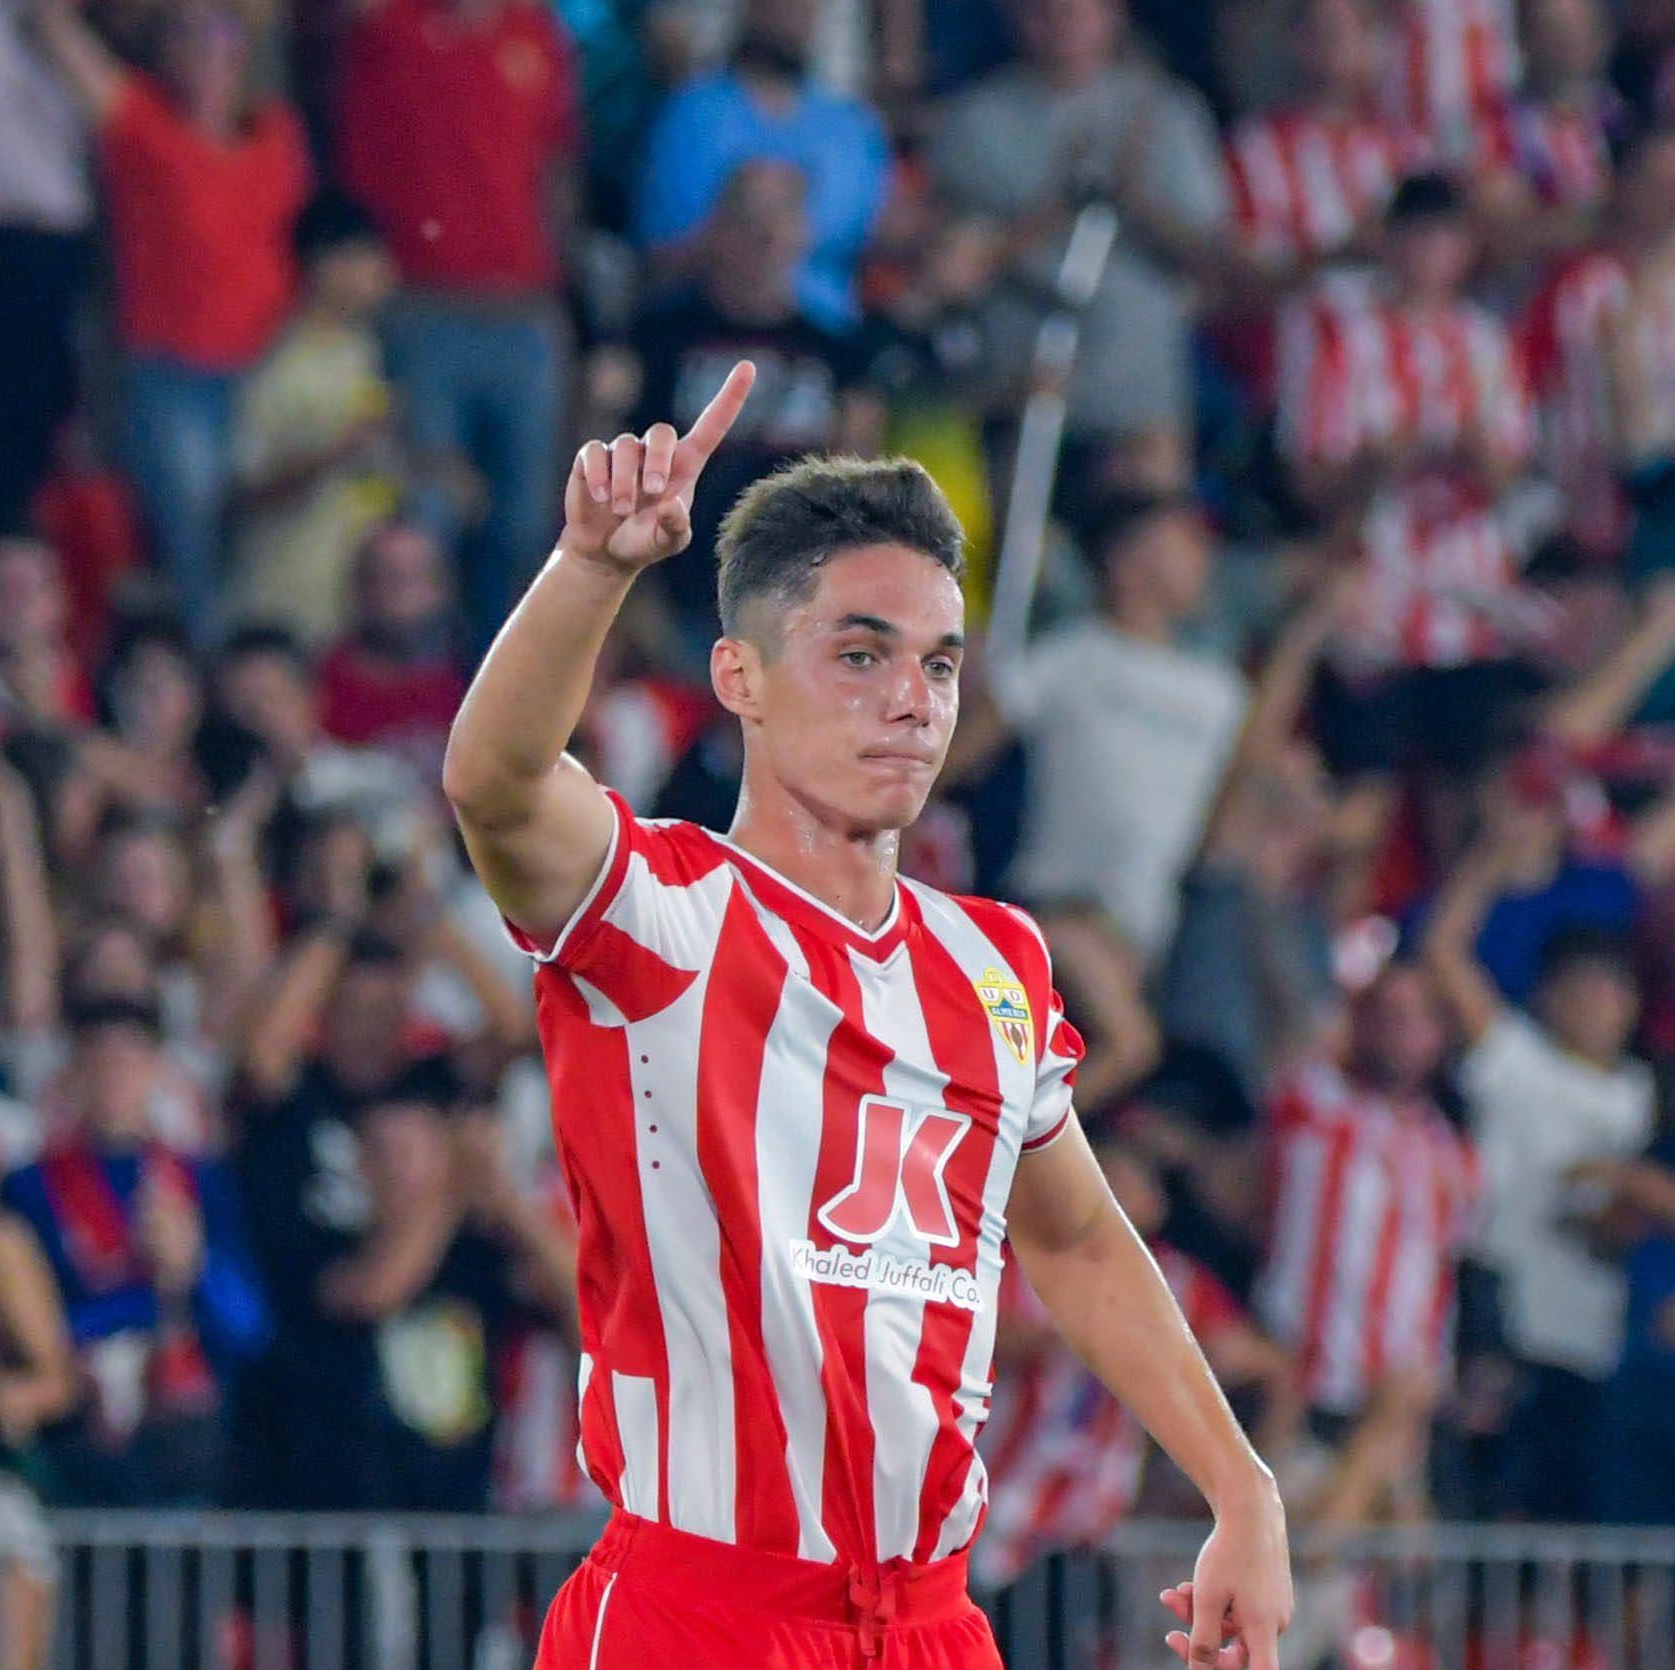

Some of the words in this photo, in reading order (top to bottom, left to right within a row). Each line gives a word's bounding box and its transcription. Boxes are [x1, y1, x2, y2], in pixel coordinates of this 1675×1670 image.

[821, 1096, 969, 1243] JK
[791, 1246, 872, 1281] Khaled
[879, 1260, 947, 1295] Juffali
[951, 1275, 981, 1304] Co.
